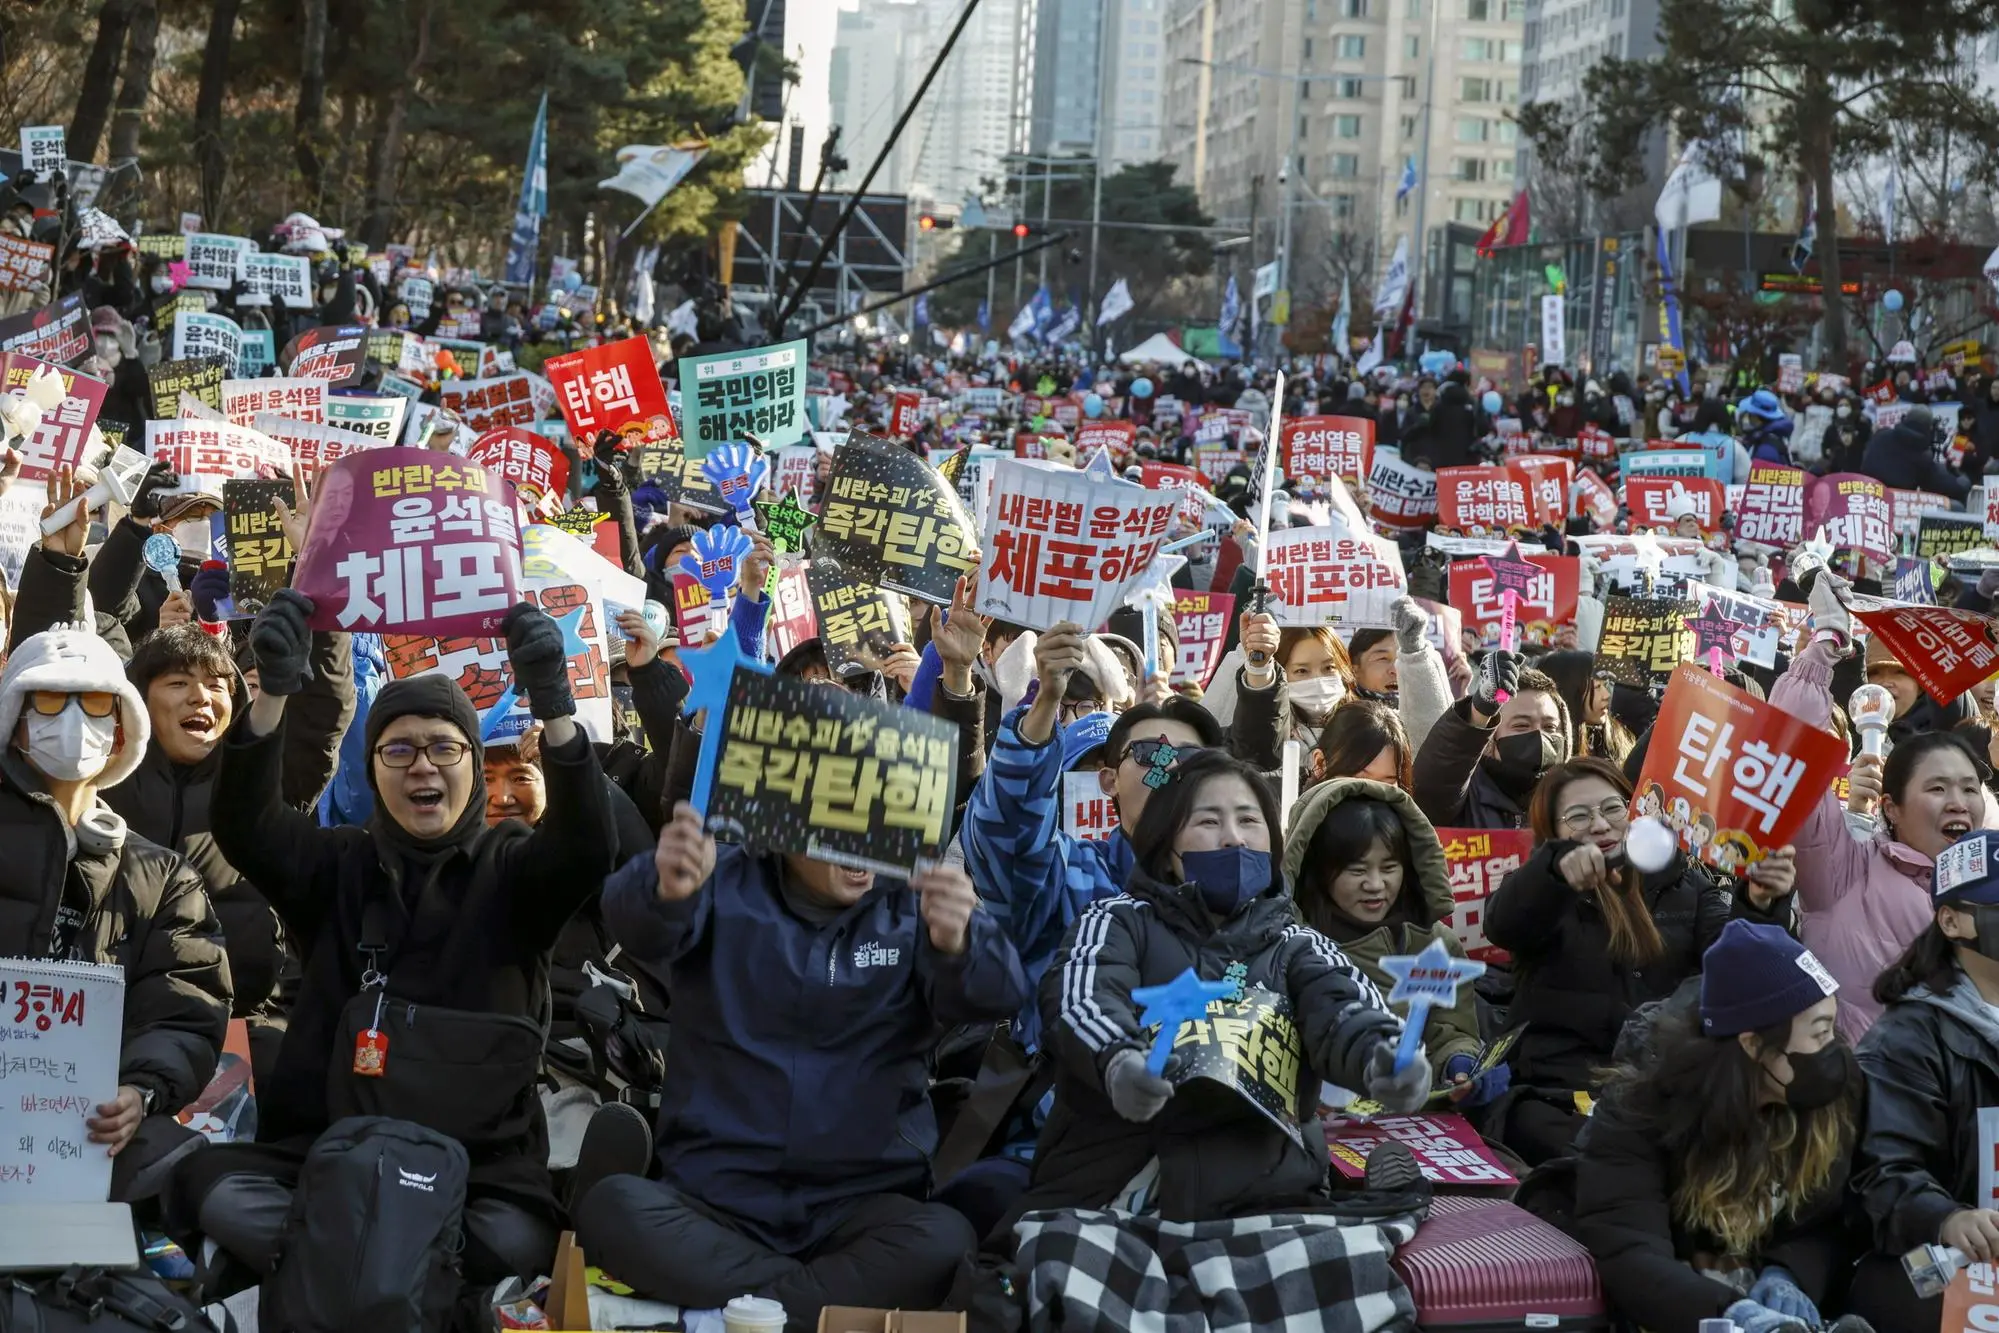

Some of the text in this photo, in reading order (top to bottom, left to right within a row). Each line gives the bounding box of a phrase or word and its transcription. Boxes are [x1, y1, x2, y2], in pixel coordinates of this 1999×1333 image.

[245, 265, 302, 282] 윤석열을
[246, 281, 304, 298] 탄핵하라
[267, 387, 322, 409] 윤석열
[564, 364, 641, 427] 탄핵
[698, 367, 796, 409] 국민의힘
[698, 400, 796, 441] 해산하라
[154, 431, 219, 448] 내란범
[1290, 430, 1362, 452] 윤석열을
[1290, 454, 1362, 476] 탄핵하라
[1750, 467, 1804, 486] 내란공범
[372, 464, 490, 498] 반란수괴
[720, 473, 750, 496] 탄핵
[832, 476, 911, 508] 내란수괴
[1456, 480, 1525, 504] 윤석열을
[1838, 480, 1884, 498] 반란수괴
[768, 504, 806, 526] 윤석열
[998, 493, 1084, 537] 내란범
[1089, 502, 1175, 539] 윤석열
[1456, 503, 1528, 526] 탄핵하라
[1847, 494, 1890, 518] 윤석열
[390, 495, 520, 546] 윤석열
[767, 521, 800, 542] 탄핵
[822, 502, 981, 575] 즉각탄핵
[1266, 540, 1331, 566] 내란범
[702, 556, 733, 580] 탄핵
[1266, 562, 1401, 608] 체포하라
[825, 600, 892, 646] 즉각
[1605, 616, 1664, 634] 내란수괴
[1695, 619, 1735, 634] 내란수괴
[1682, 668, 1708, 689] 나눔문화
[729, 704, 951, 771] 내란수괴 윤석열
[1672, 711, 1807, 835] 탄핵
[719, 739, 951, 846] 즉각탄핵
[14, 980, 85, 1032] 3행시
[18, 1135, 34, 1155] 왜
[399, 1178, 435, 1193] BUFFALO
